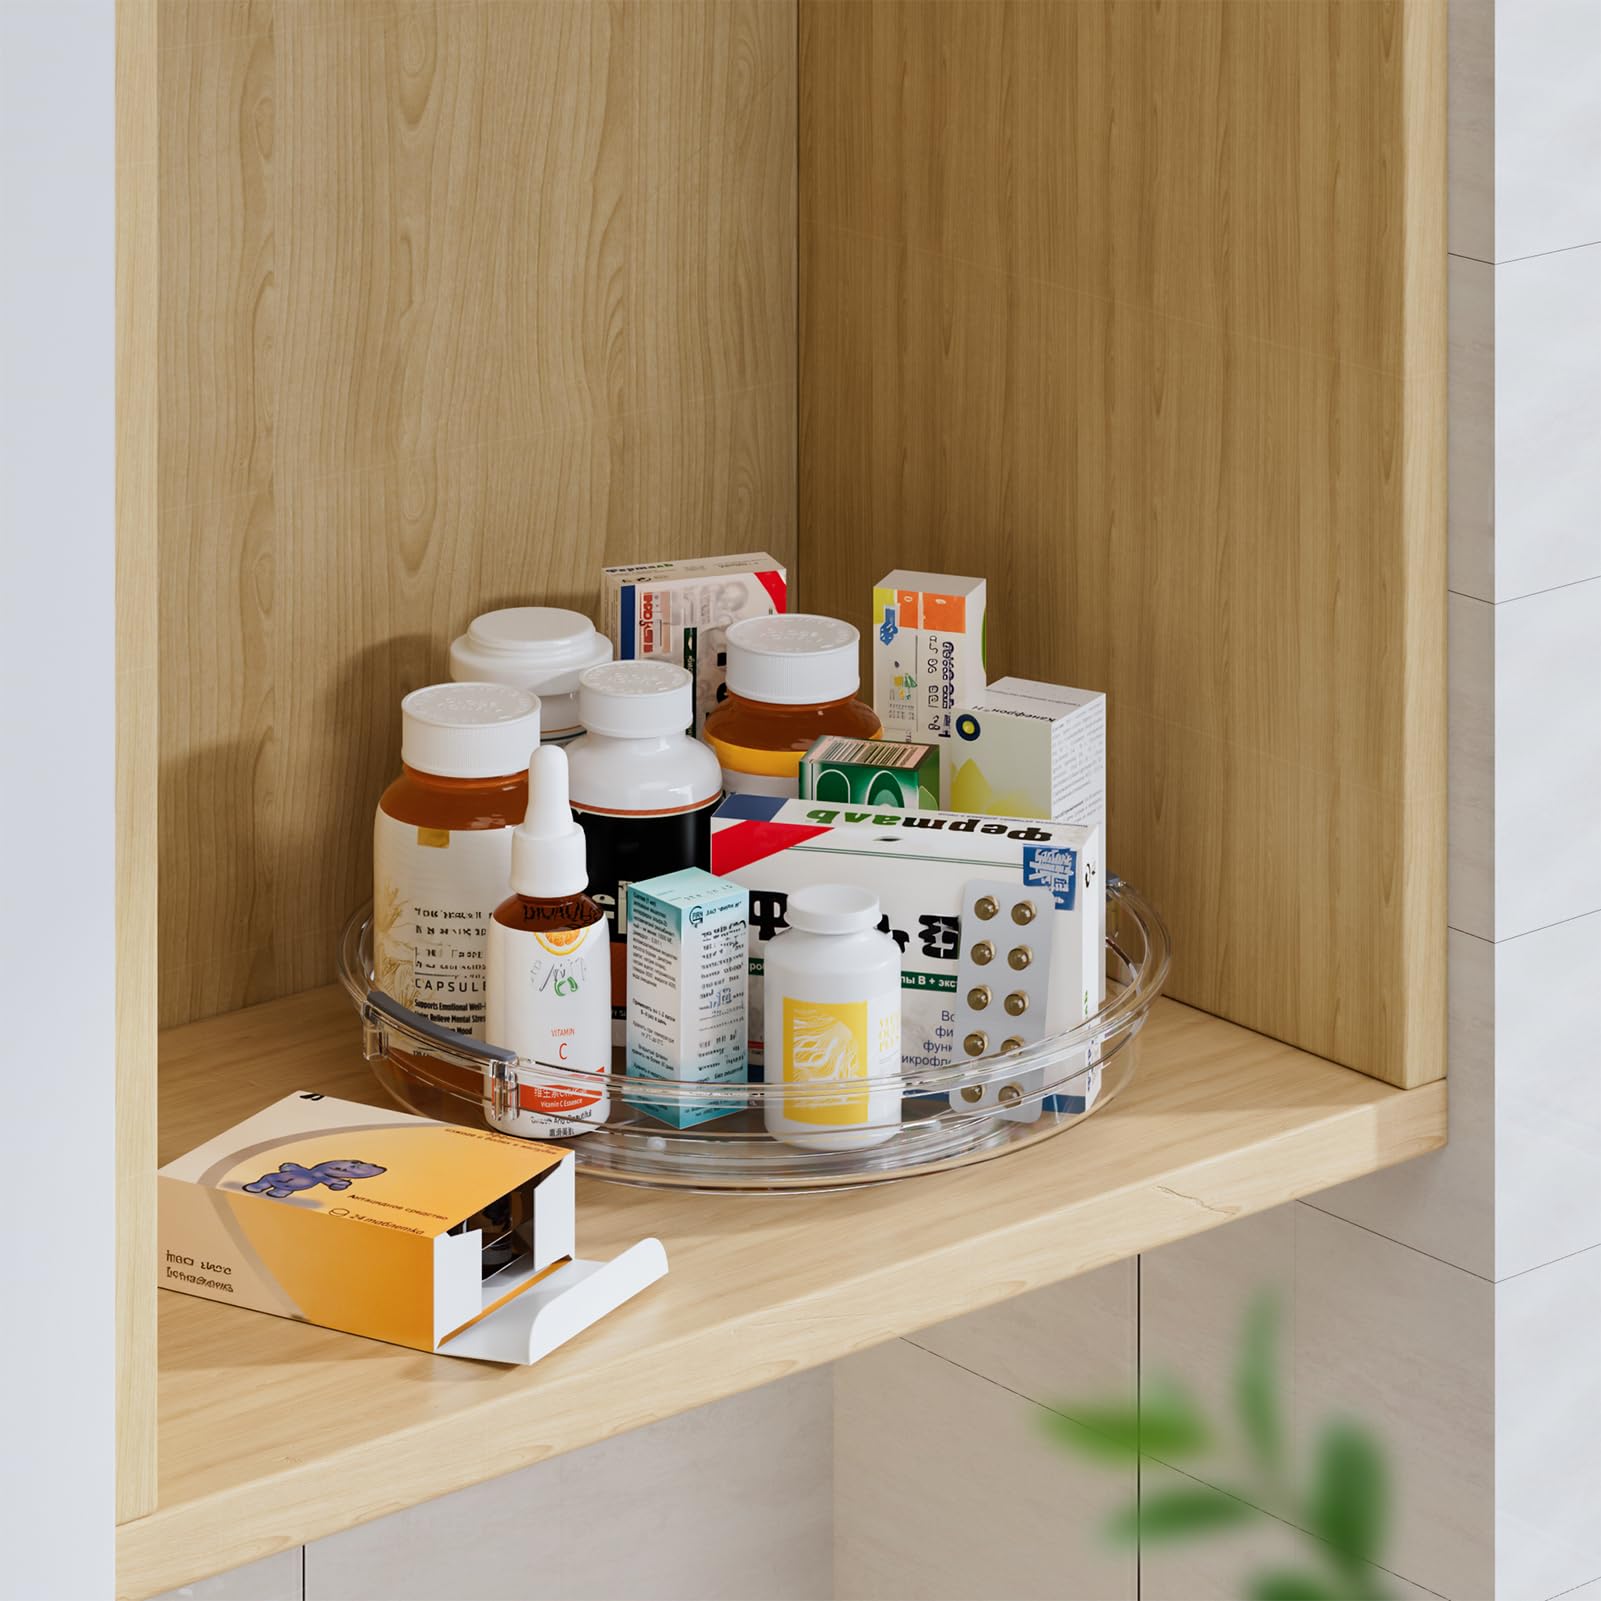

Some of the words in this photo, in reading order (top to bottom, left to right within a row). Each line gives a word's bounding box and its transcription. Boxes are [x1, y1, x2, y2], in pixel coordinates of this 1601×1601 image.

[938, 979, 957, 988] экс
[415, 999, 438, 1010] Supports
[439, 1002, 467, 1011] Emotional
[469, 1002, 486, 1011] Well-
[551, 1028, 575, 1037] VITAMIN
[935, 1026, 954, 1039] фи
[559, 1042, 567, 1060] C
[901, 1055, 951, 1067] икрофл
[540, 1100, 559, 1108] Vitamin
